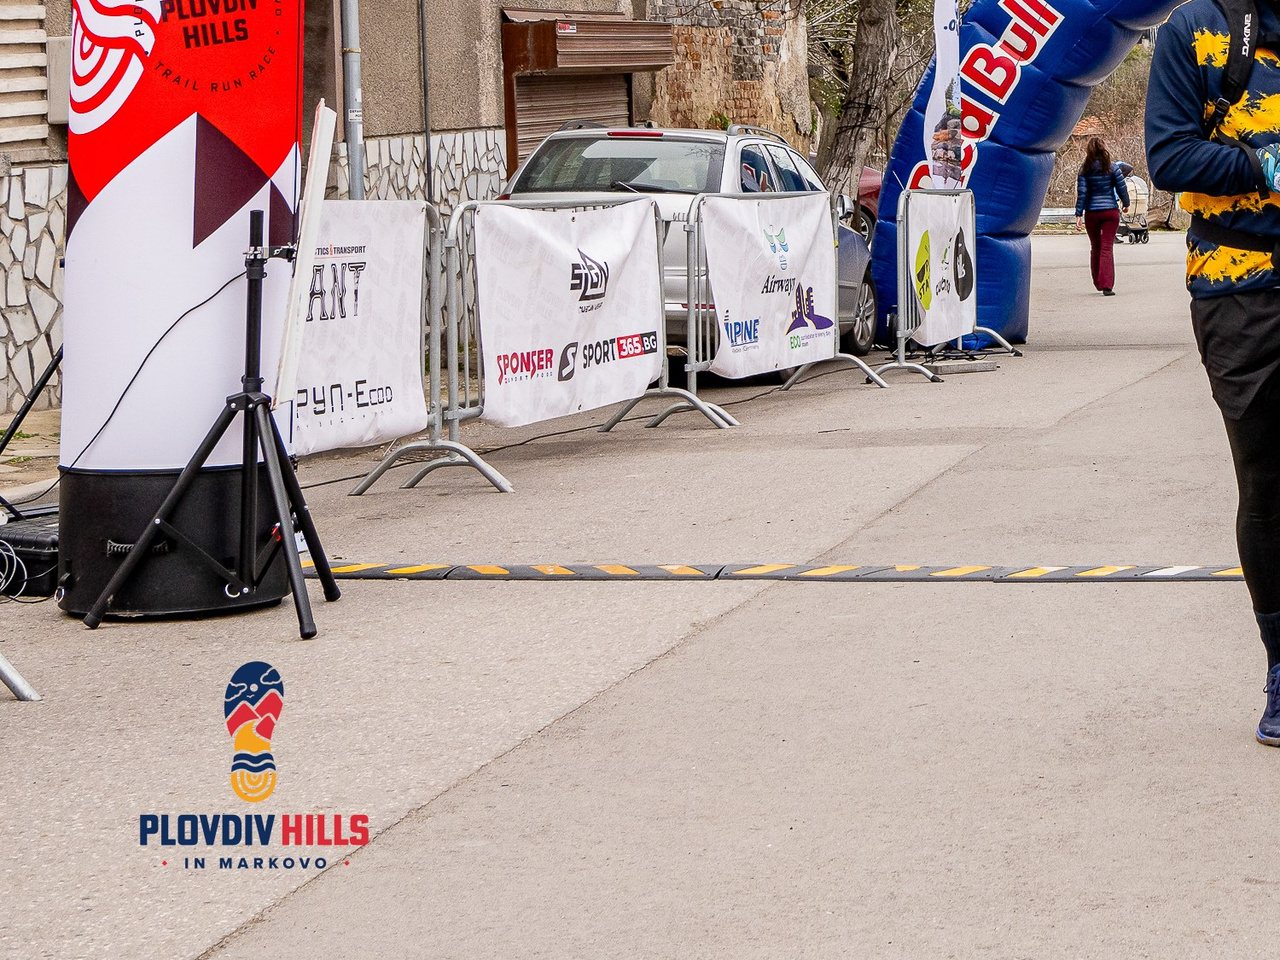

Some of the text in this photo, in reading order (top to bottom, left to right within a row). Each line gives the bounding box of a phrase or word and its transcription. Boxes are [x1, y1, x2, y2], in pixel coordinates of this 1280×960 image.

[182, 18, 249, 49] HILLS
[1241, 13, 1252, 58] DAKINE
[154, 61, 243, 92] TRAIL RUN
[248, 46, 277, 80] RACE
[333, 245, 367, 255] TRANSPORT
[497, 348, 554, 385] SPONSER
[583, 338, 616, 369] SPORT
